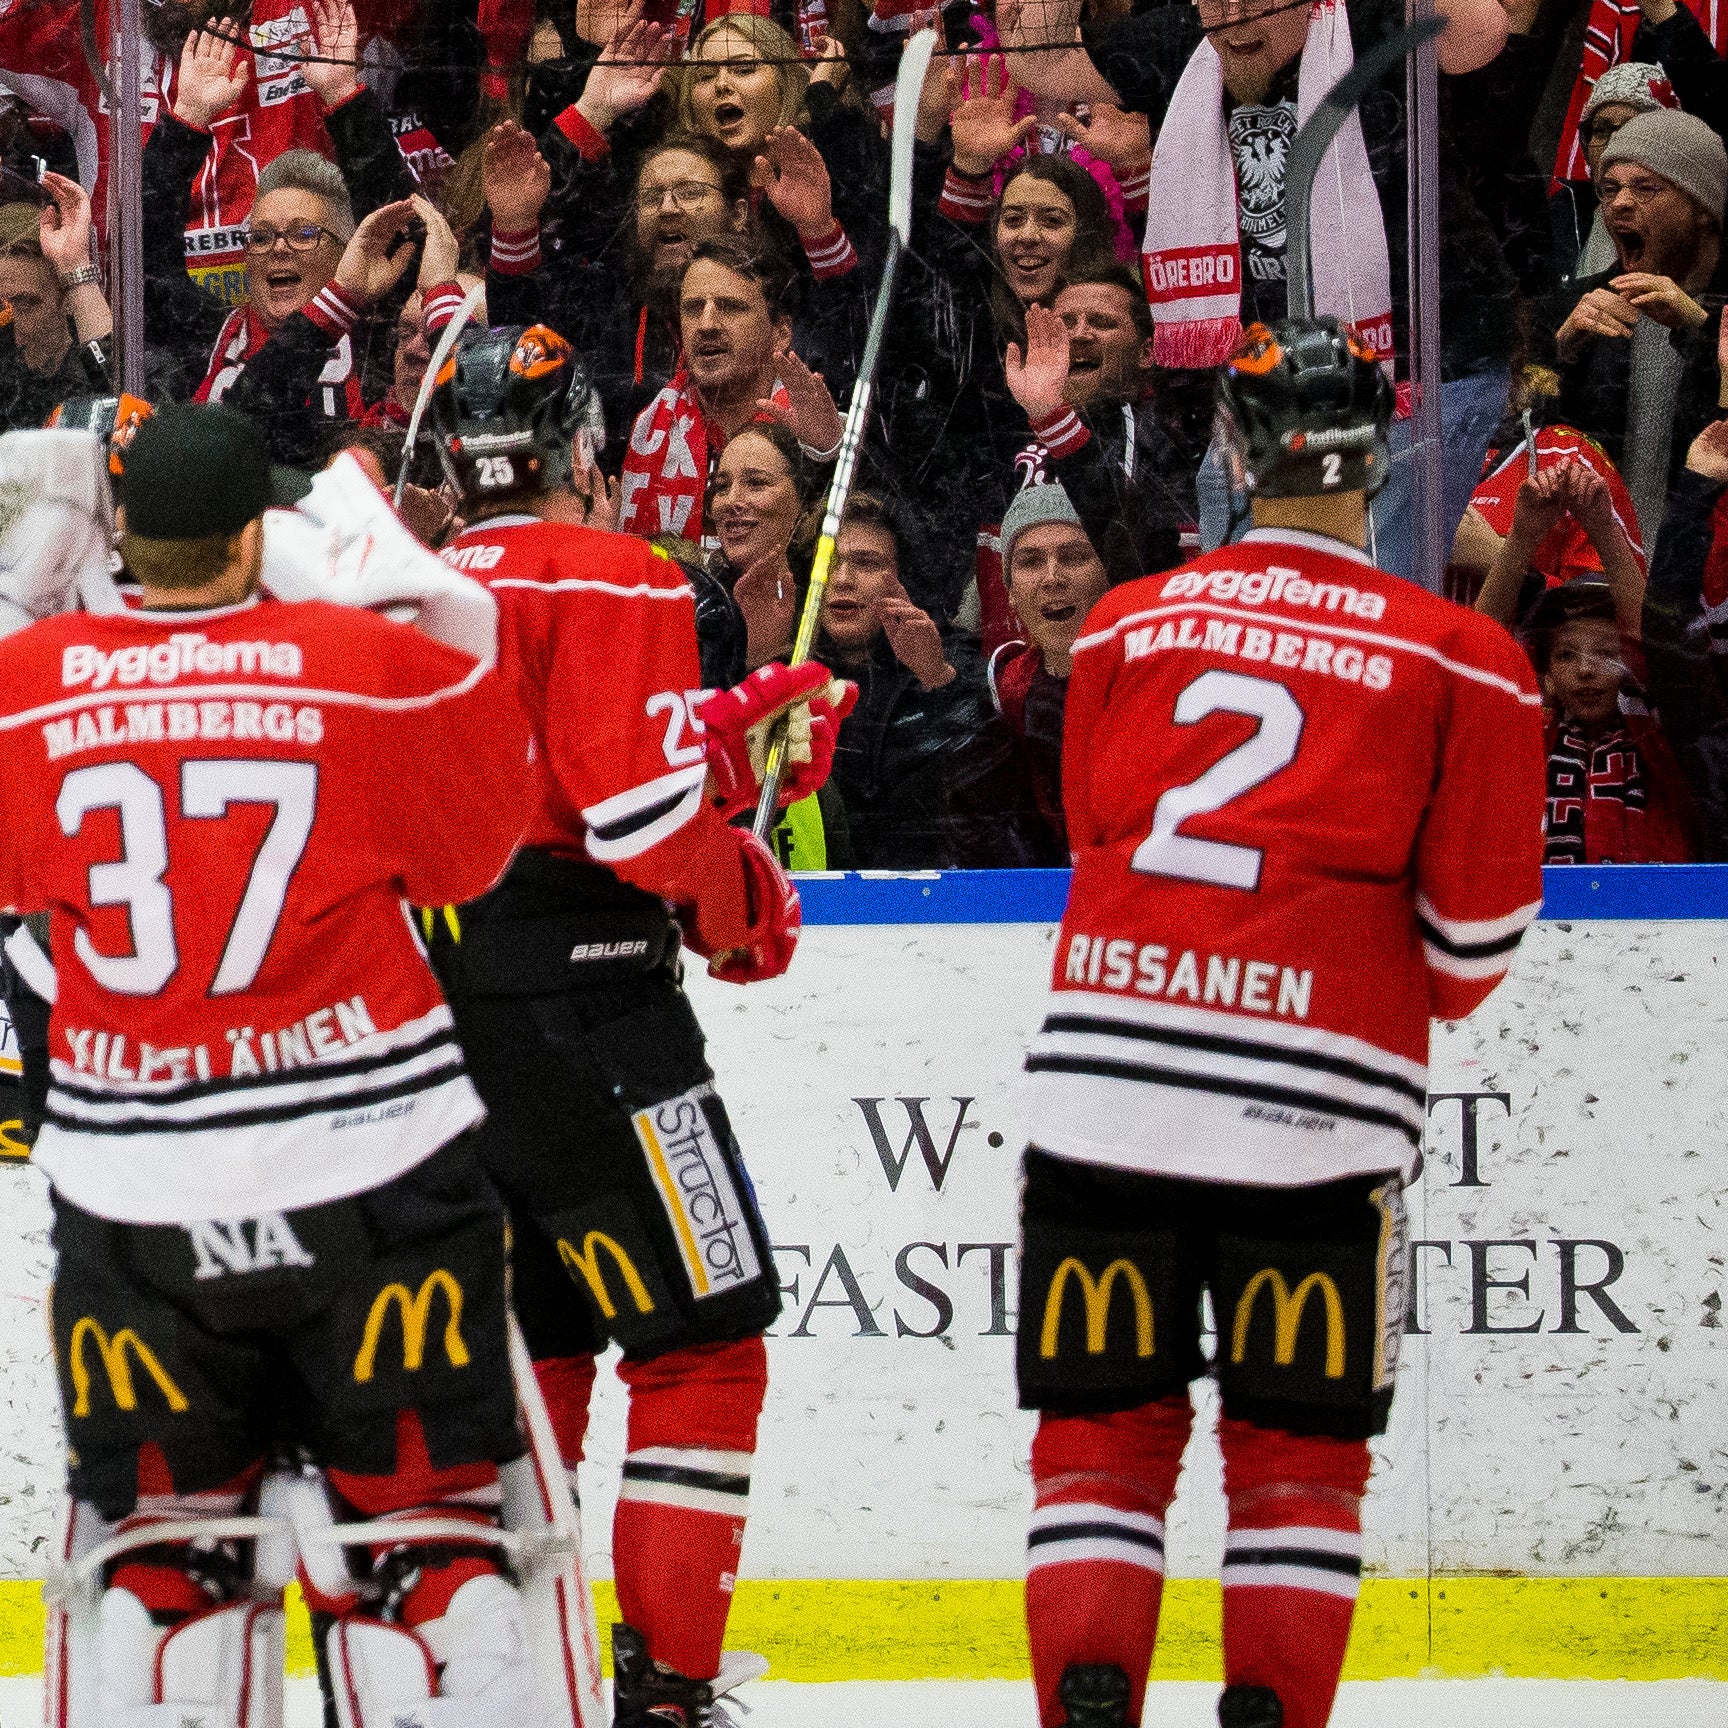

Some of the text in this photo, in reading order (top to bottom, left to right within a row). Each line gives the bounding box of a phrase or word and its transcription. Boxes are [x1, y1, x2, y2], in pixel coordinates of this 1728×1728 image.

[1148, 252, 1235, 293] ÖREBRO
[475, 455, 515, 488] 25
[1322, 454, 1343, 485] 2
[1159, 566, 1388, 622] ByggTema
[62, 632, 303, 688] ByggTema
[1123, 616, 1394, 690] MALMBERGS
[43, 702, 324, 760] MALMBERGS
[1130, 668, 1306, 893] 2
[56, 758, 318, 998] 37
[569, 936, 650, 964] BAUER
[1064, 931, 1314, 1021] RISSANEN
[654, 1098, 756, 1284] Structor
[186, 1215, 314, 1280] NA
